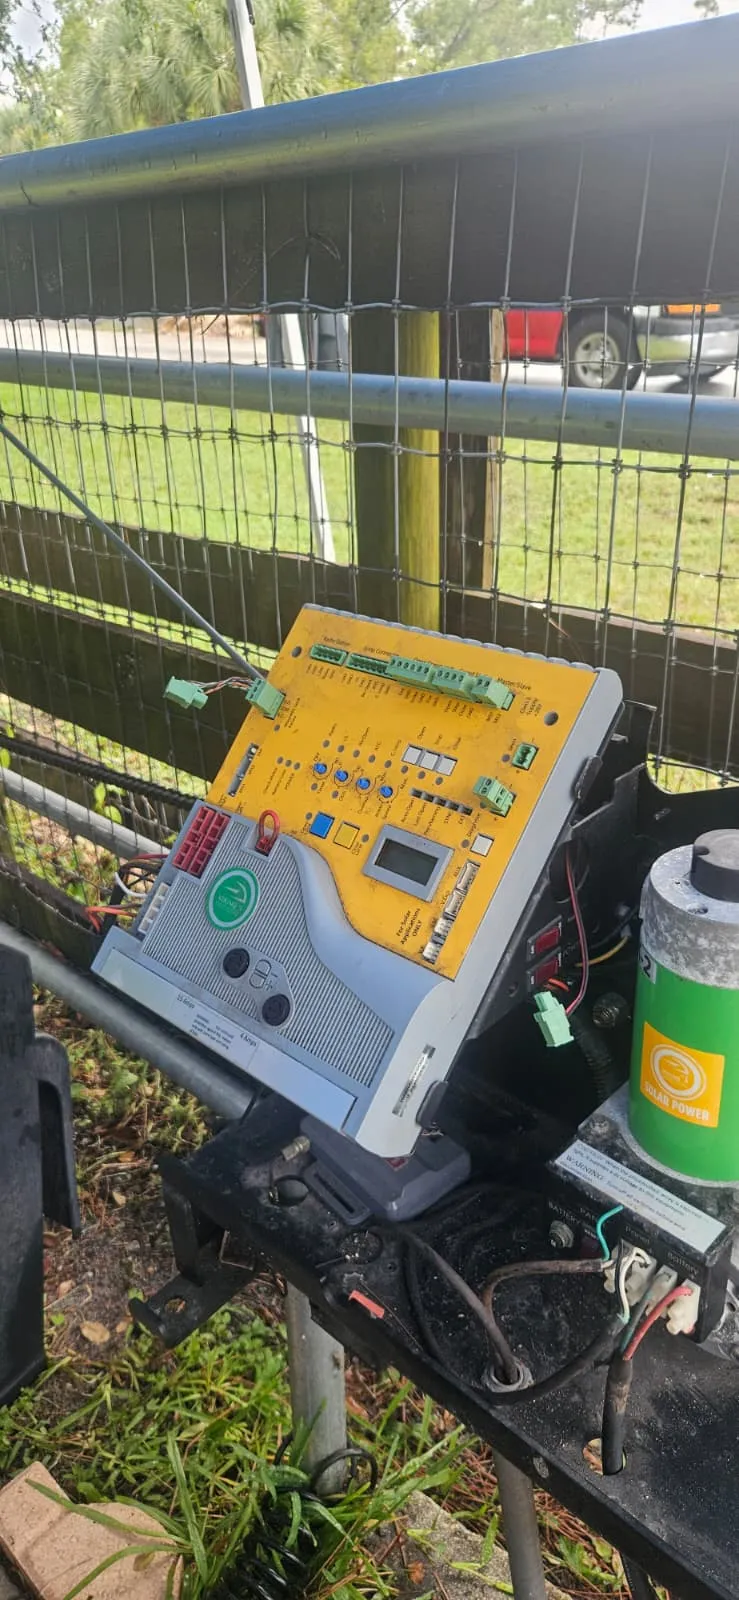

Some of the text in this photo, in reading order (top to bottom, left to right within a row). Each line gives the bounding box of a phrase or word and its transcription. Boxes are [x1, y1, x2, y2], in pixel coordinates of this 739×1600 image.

[399, 907, 422, 945] Applications
[411, 919, 423, 937] ONLY
[644, 1080, 710, 1121] SOLAR POWER
[665, 1252, 700, 1276] Battery
